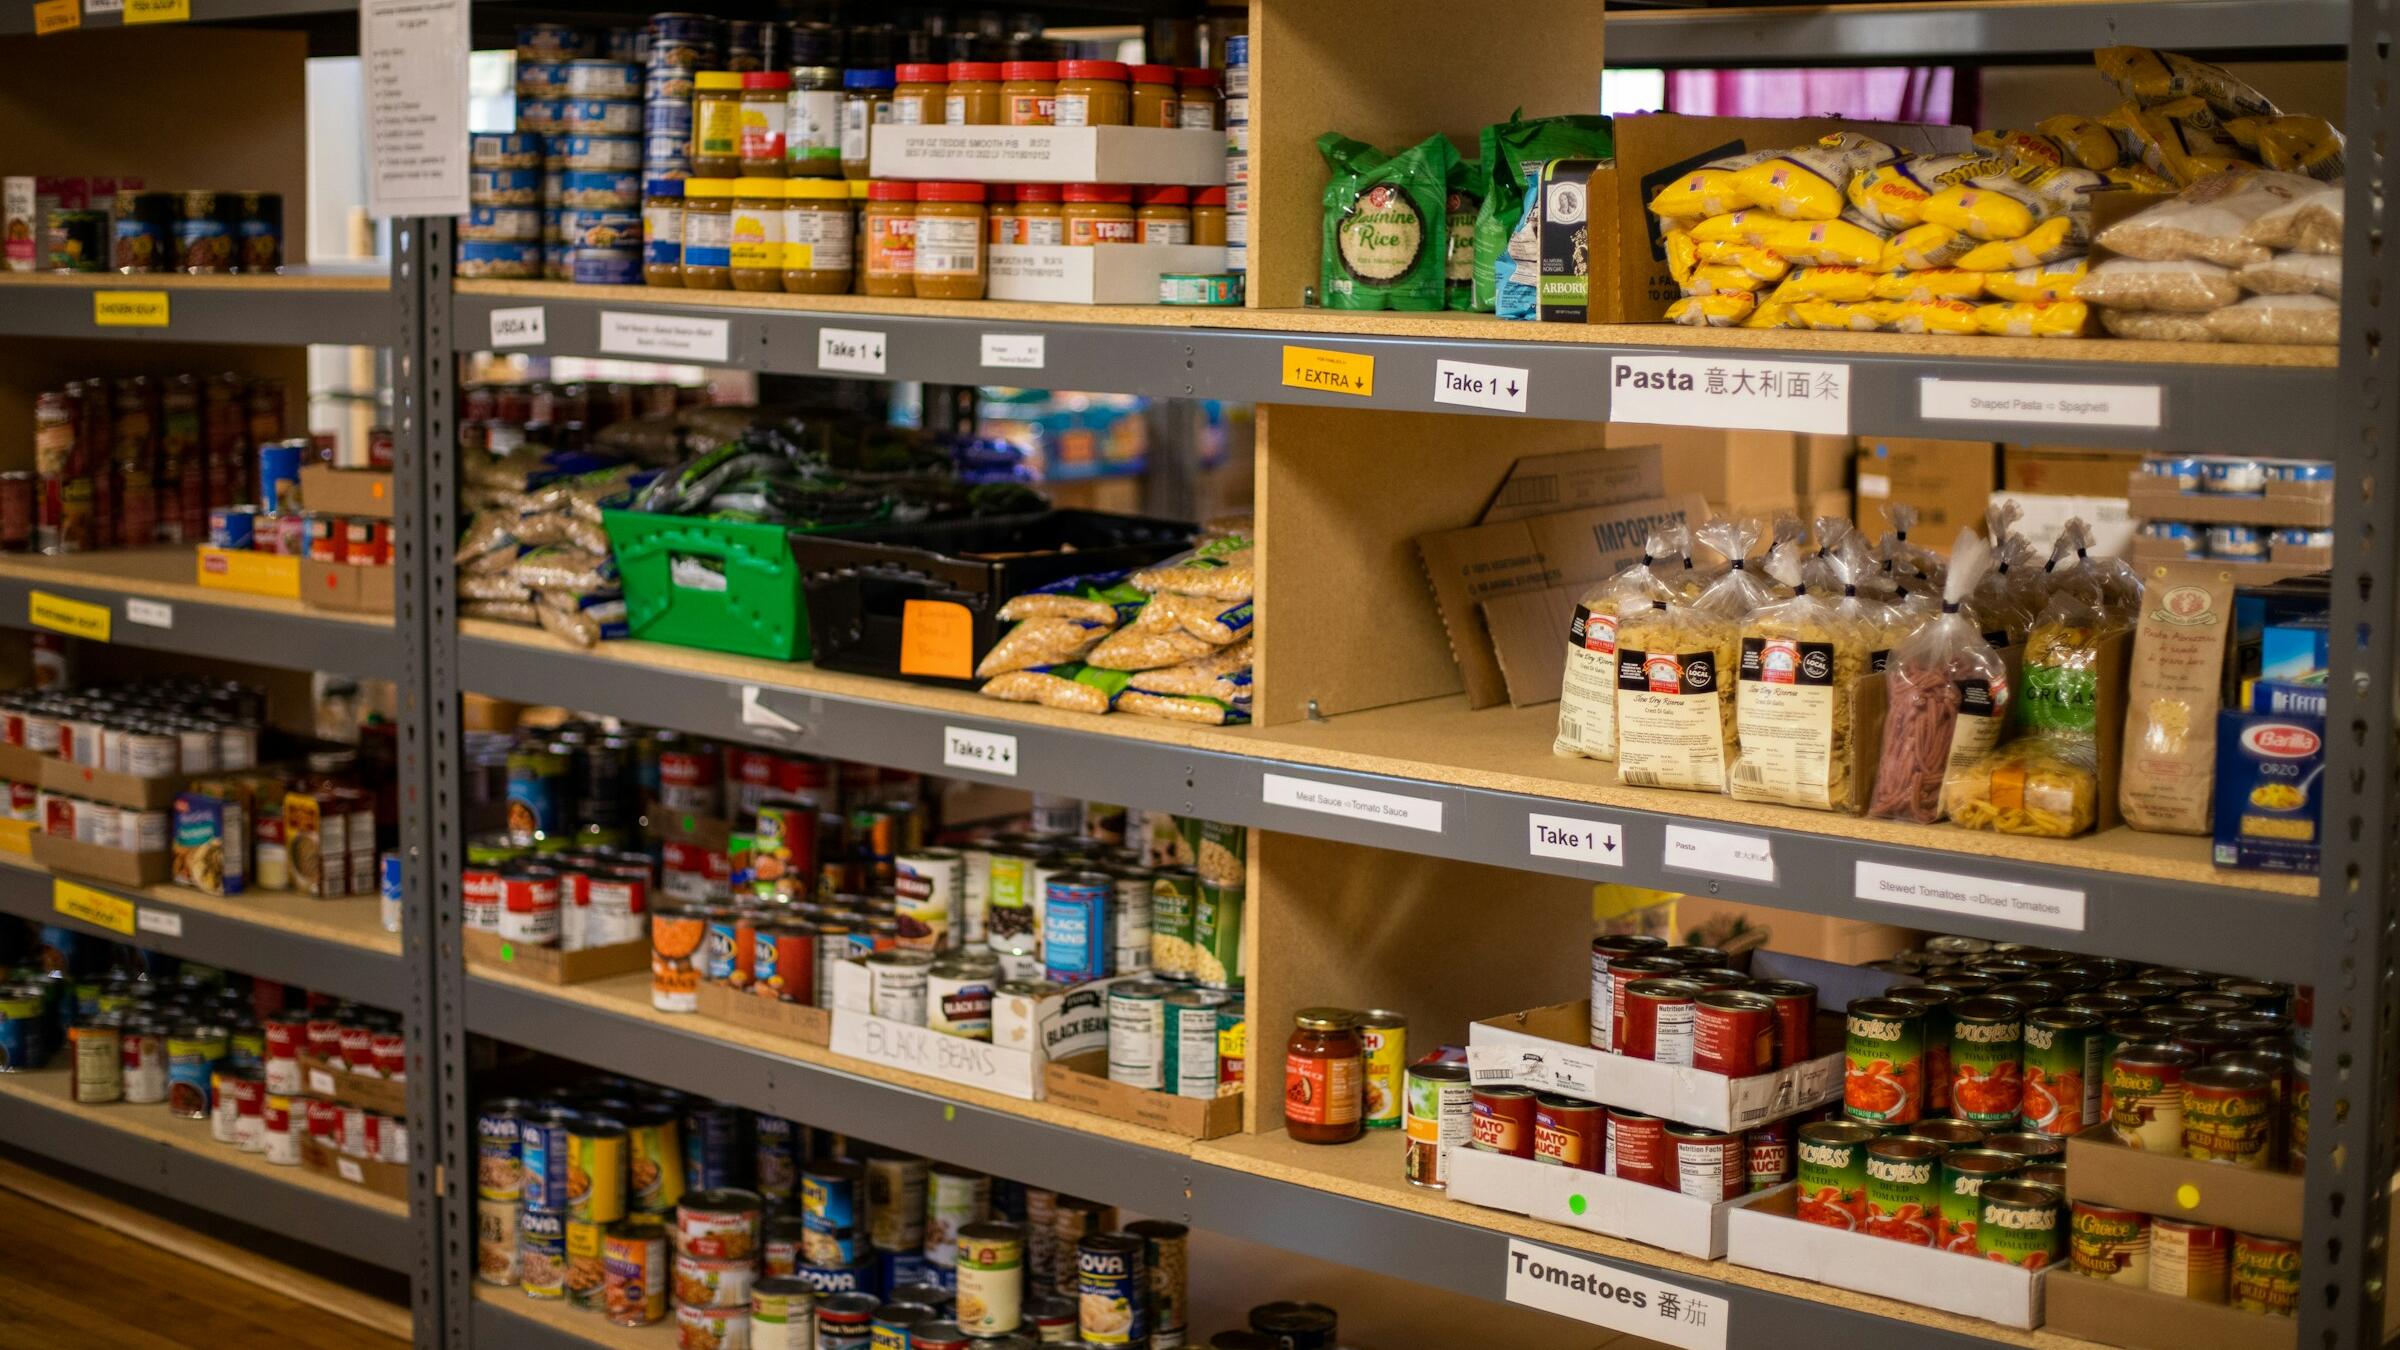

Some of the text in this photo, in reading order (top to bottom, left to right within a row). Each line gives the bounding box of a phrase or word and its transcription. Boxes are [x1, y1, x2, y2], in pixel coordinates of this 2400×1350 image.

[1359, 225, 1399, 250] Rice
[1648, 289, 1660, 300] TO
[494, 320, 527, 335] USDA
[826, 339, 867, 359] Take 1
[1295, 367, 1349, 388] 1 EXTRA
[1443, 371, 1497, 395] Take 1
[1615, 364, 1694, 391] Pasta
[1703, 366, 1840, 401] 意大利面条
[1970, 397, 2110, 415] Shaped Pasta Spaghetti
[1688, 669, 1709, 678] LOCAL
[1807, 659, 1826, 669] LOCAL
[952, 738, 996, 761] Take 2
[2259, 730, 2314, 750] Barilla
[2259, 762, 2299, 777] ORZO
[1296, 791, 1409, 818] Meat Sauce Tomato Sauce
[1537, 825, 1594, 850] Take 1
[1675, 841, 1696, 851] Pasta
[1879, 880, 2061, 914] Stewed Tomatoes Diced Tomatoes
[1658, 1004, 1685, 1012] Nutrition
[1047, 1022, 1080, 1047] BLACK
[865, 1019, 997, 1077] BLACK BEANS
[1964, 1051, 2014, 1062] TOMATOES
[1679, 1145, 1704, 1153] Nutrition
[1713, 1167, 1722, 1175] 25
[1872, 1190, 1921, 1203] TOMATOES
[1879, 1182, 1910, 1193] DICED
[2004, 1230, 2038, 1240] DICED
[2080, 1214, 2130, 1236] Choice
[1992, 1240, 2048, 1251] TOMATOES
[1511, 1251, 1648, 1310] Tomatoes
[1656, 1290, 1709, 1328] 番茄
